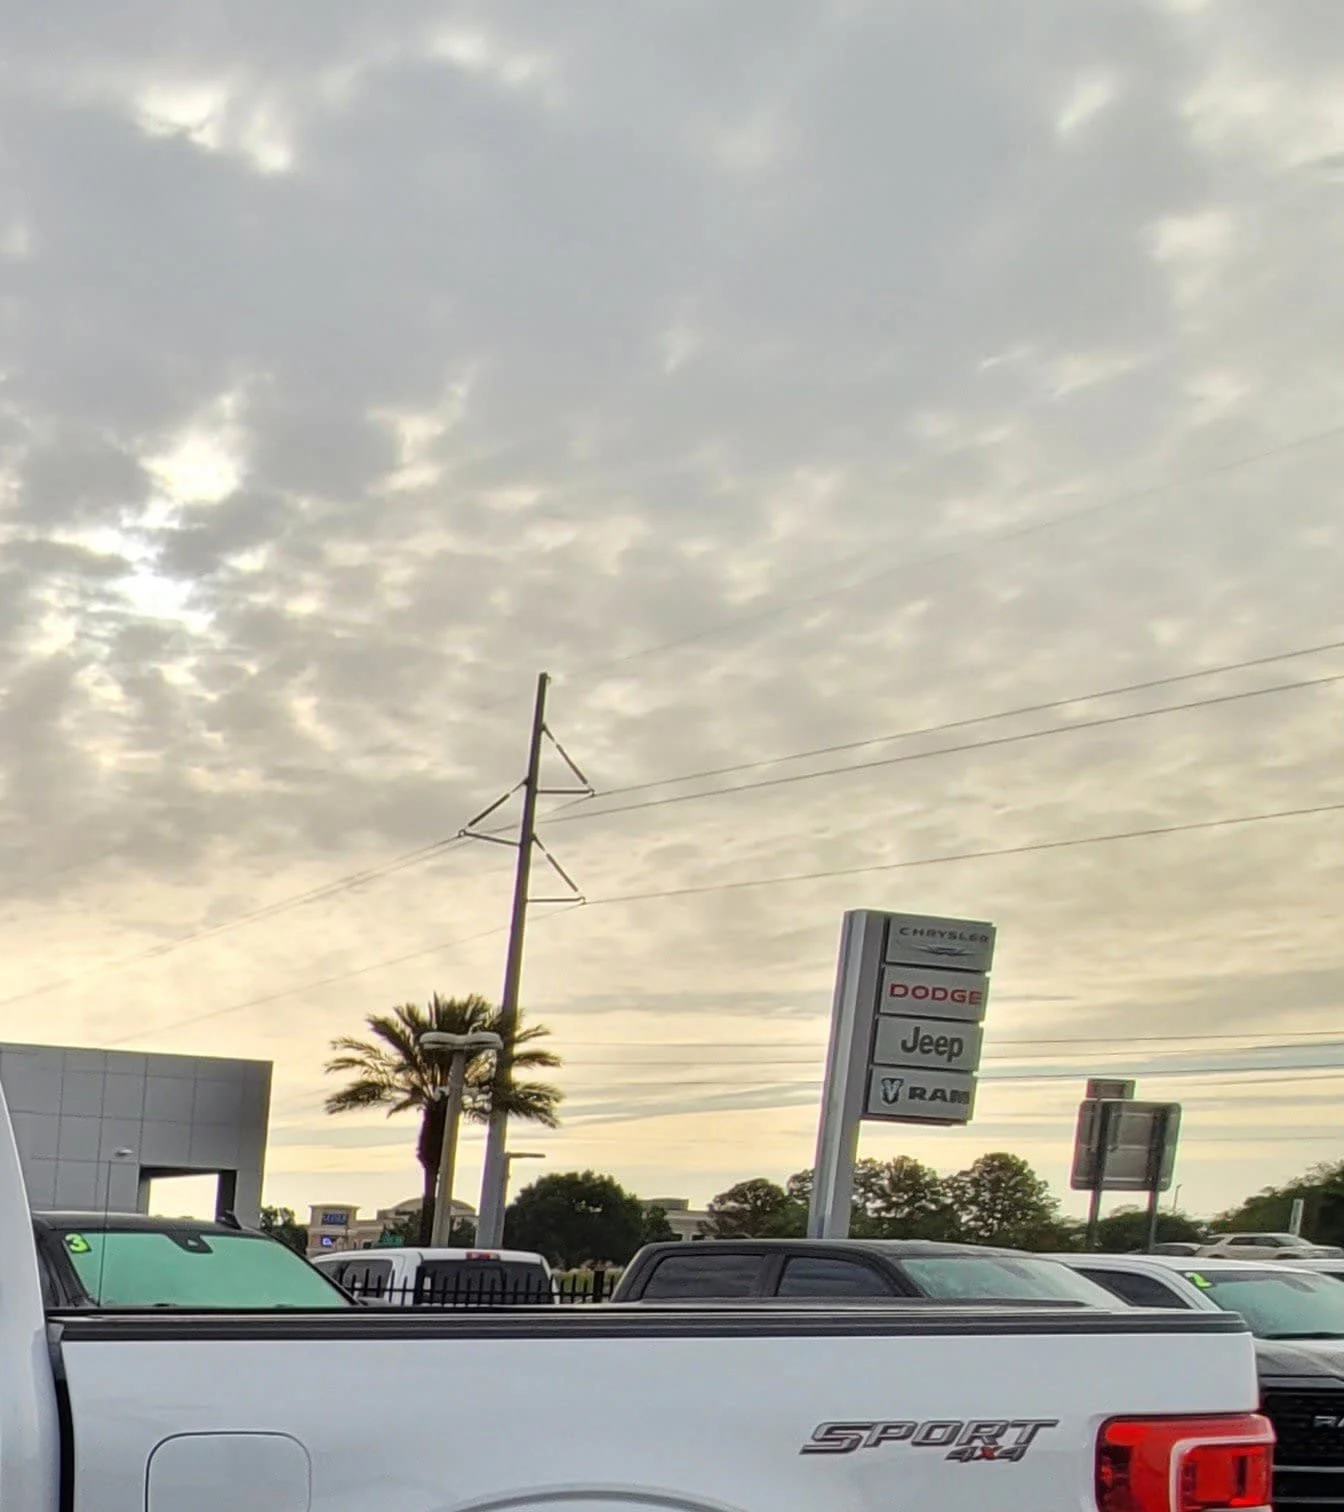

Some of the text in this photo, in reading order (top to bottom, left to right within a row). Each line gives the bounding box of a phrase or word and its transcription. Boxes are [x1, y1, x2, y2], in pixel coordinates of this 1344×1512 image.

[898, 926, 989, 943] CHRYSLER
[889, 983, 984, 1006] DODGE
[900, 1025, 964, 1063] Jeep
[908, 1086, 970, 1105] RAM
[64, 1233, 88, 1251] 3
[798, 1419, 1061, 1455] SPORT
